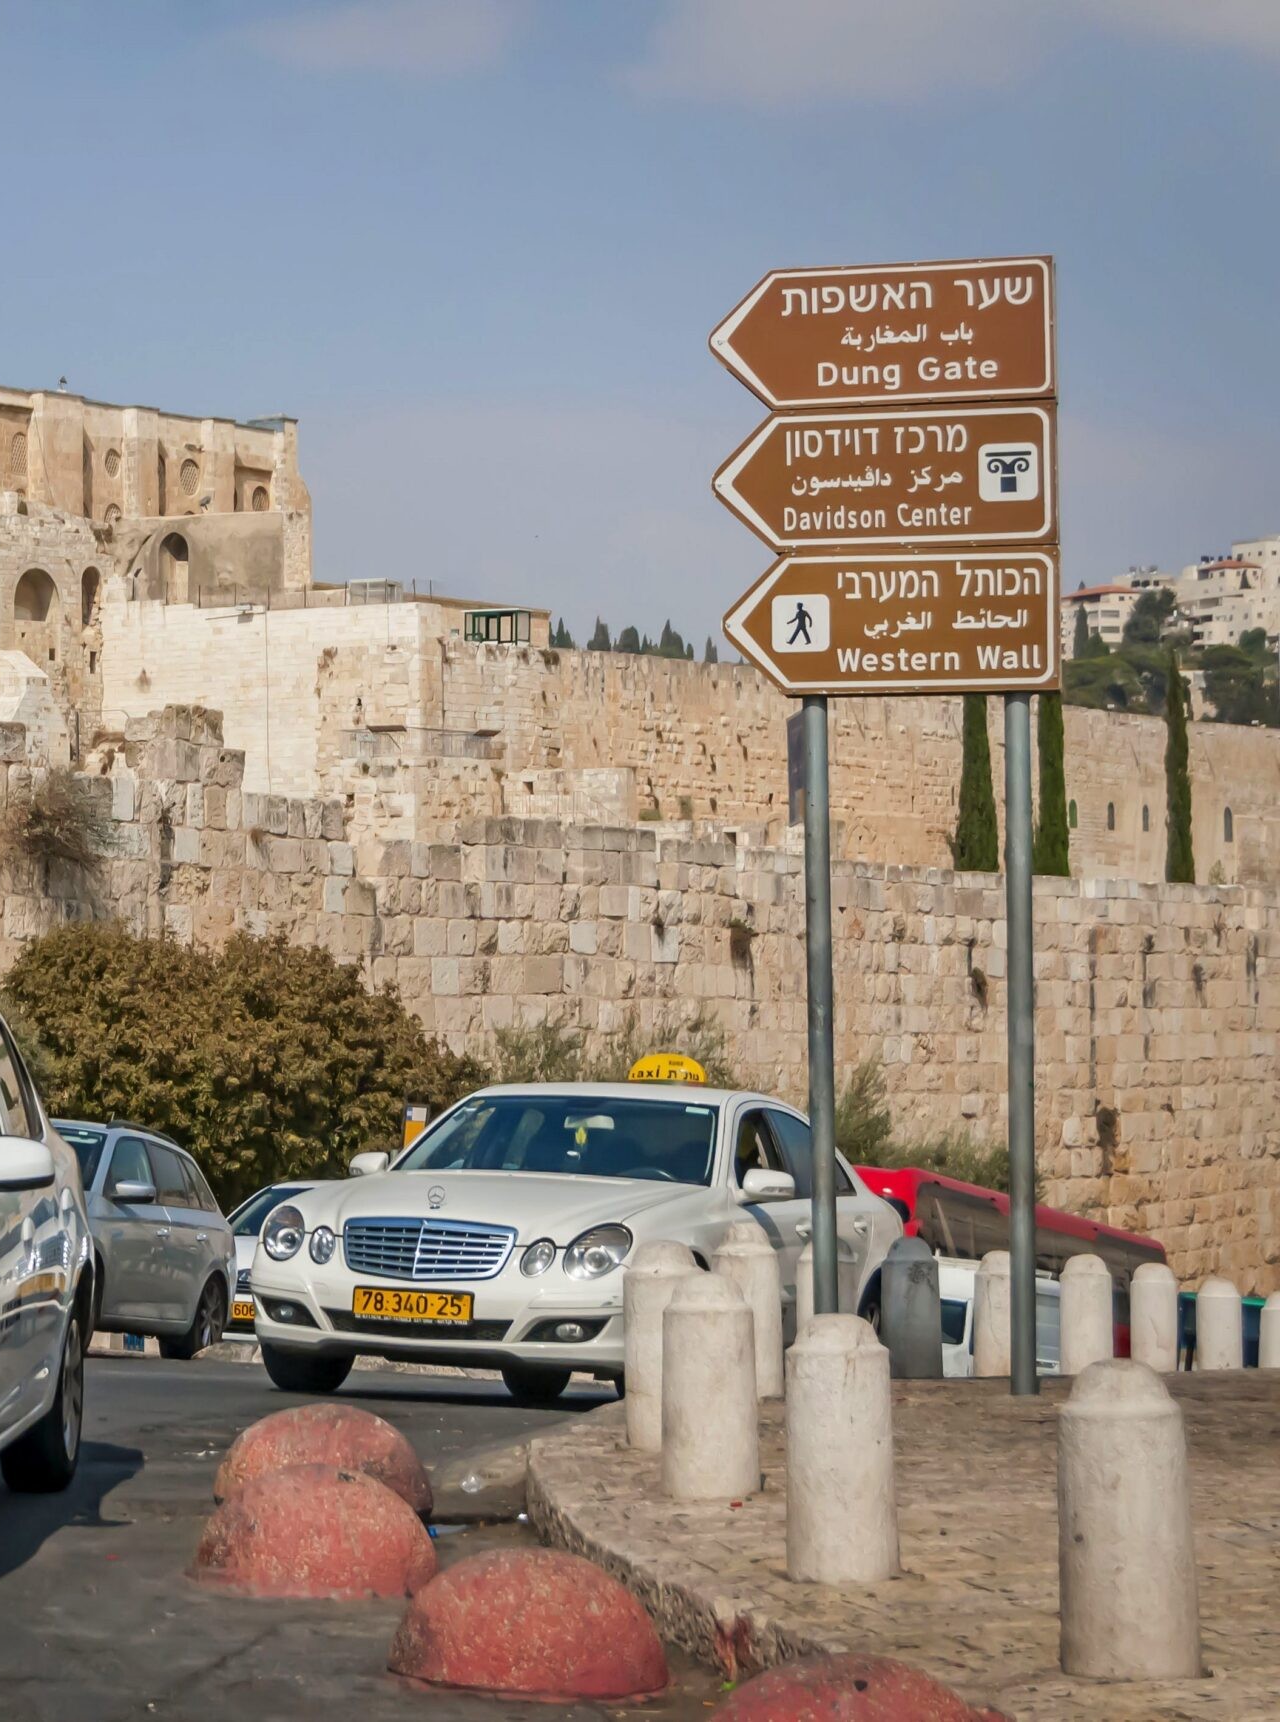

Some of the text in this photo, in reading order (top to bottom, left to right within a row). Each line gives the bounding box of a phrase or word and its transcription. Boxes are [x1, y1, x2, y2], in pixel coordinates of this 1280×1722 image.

[781, 277, 1033, 317] שער האשפות
[840, 322, 974, 353] باب المغاربة
[817, 357, 999, 391] Dung Gate
[785, 424, 968, 466] מרכז דוידסון
[907, 466, 964, 493] مركز
[783, 503, 972, 532] Davidson Center
[837, 561, 1041, 603] הכותל המערבי
[863, 608, 1028, 640] الحائط الغربي
[836, 645, 1041, 673] Western Wall
